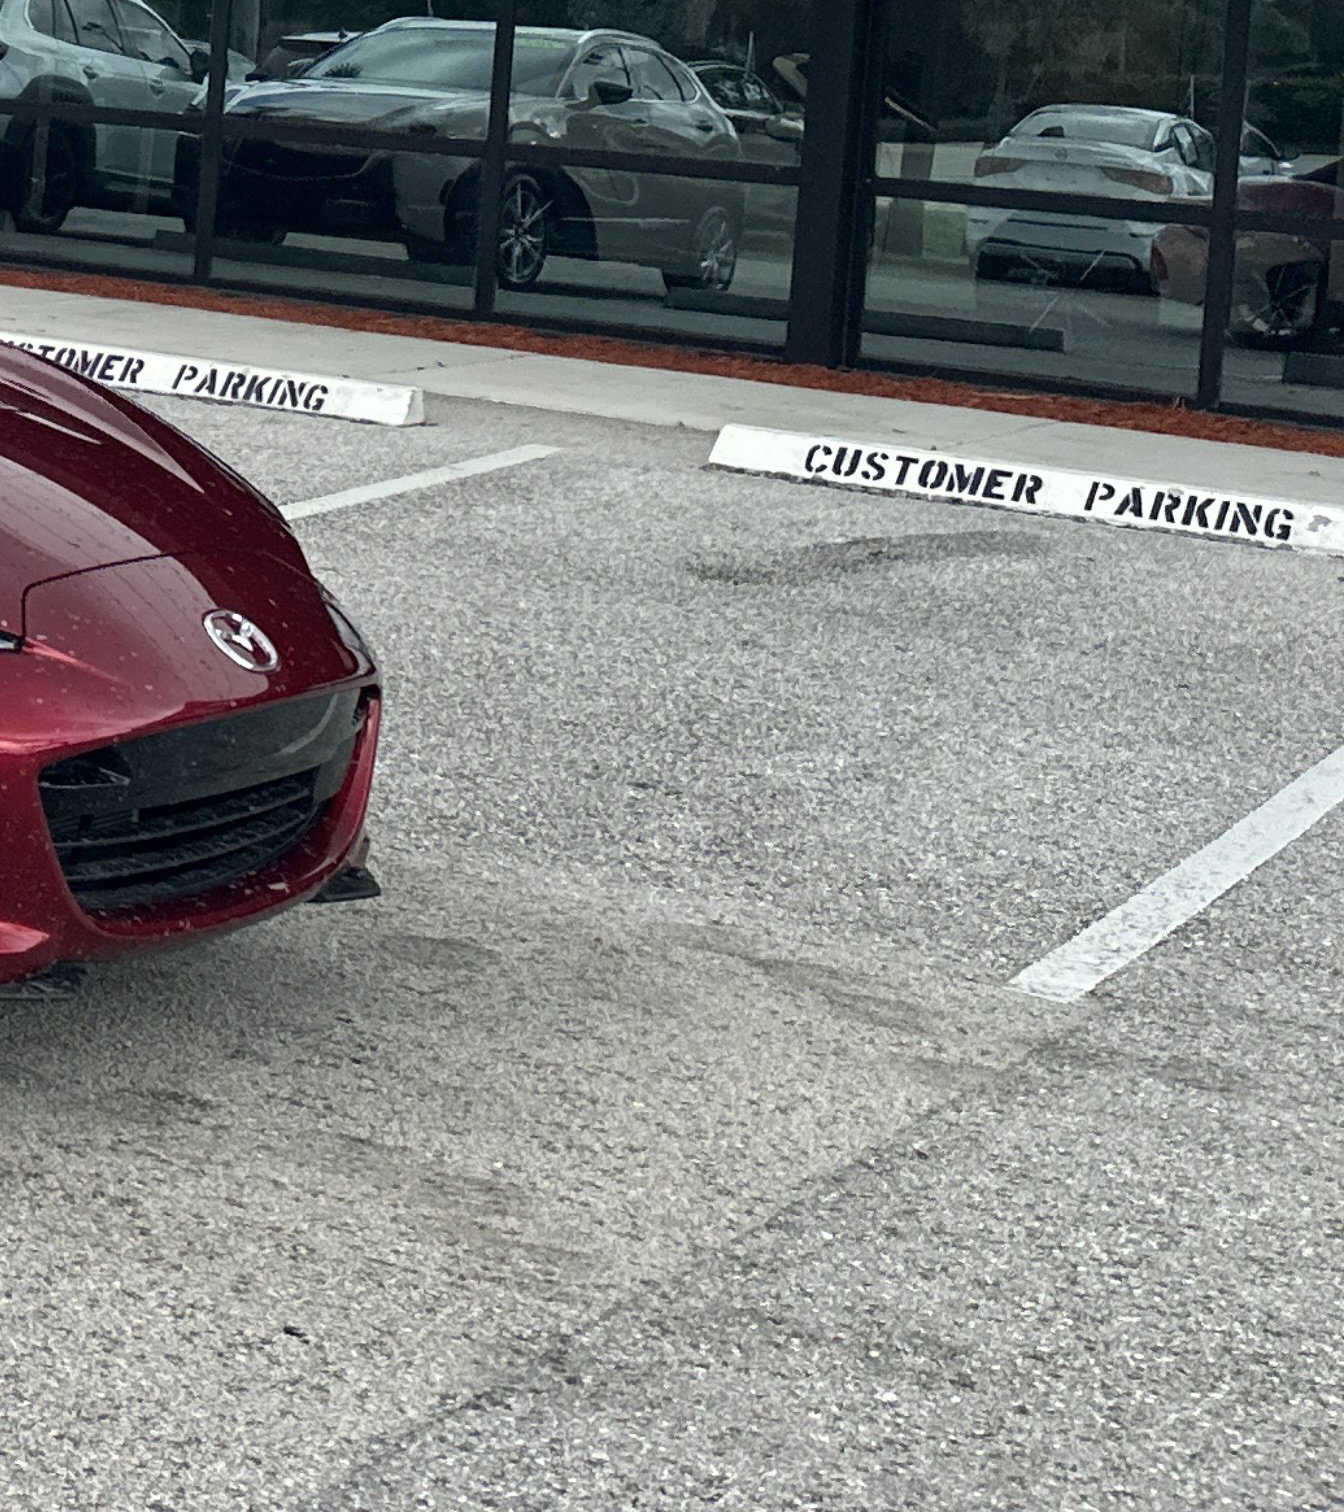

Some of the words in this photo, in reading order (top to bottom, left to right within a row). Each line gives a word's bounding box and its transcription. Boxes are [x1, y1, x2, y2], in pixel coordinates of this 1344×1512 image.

[172, 364, 329, 411] PARKING
[804, 444, 1043, 504] CUSTOMER
[1084, 481, 1295, 541] PARKING
